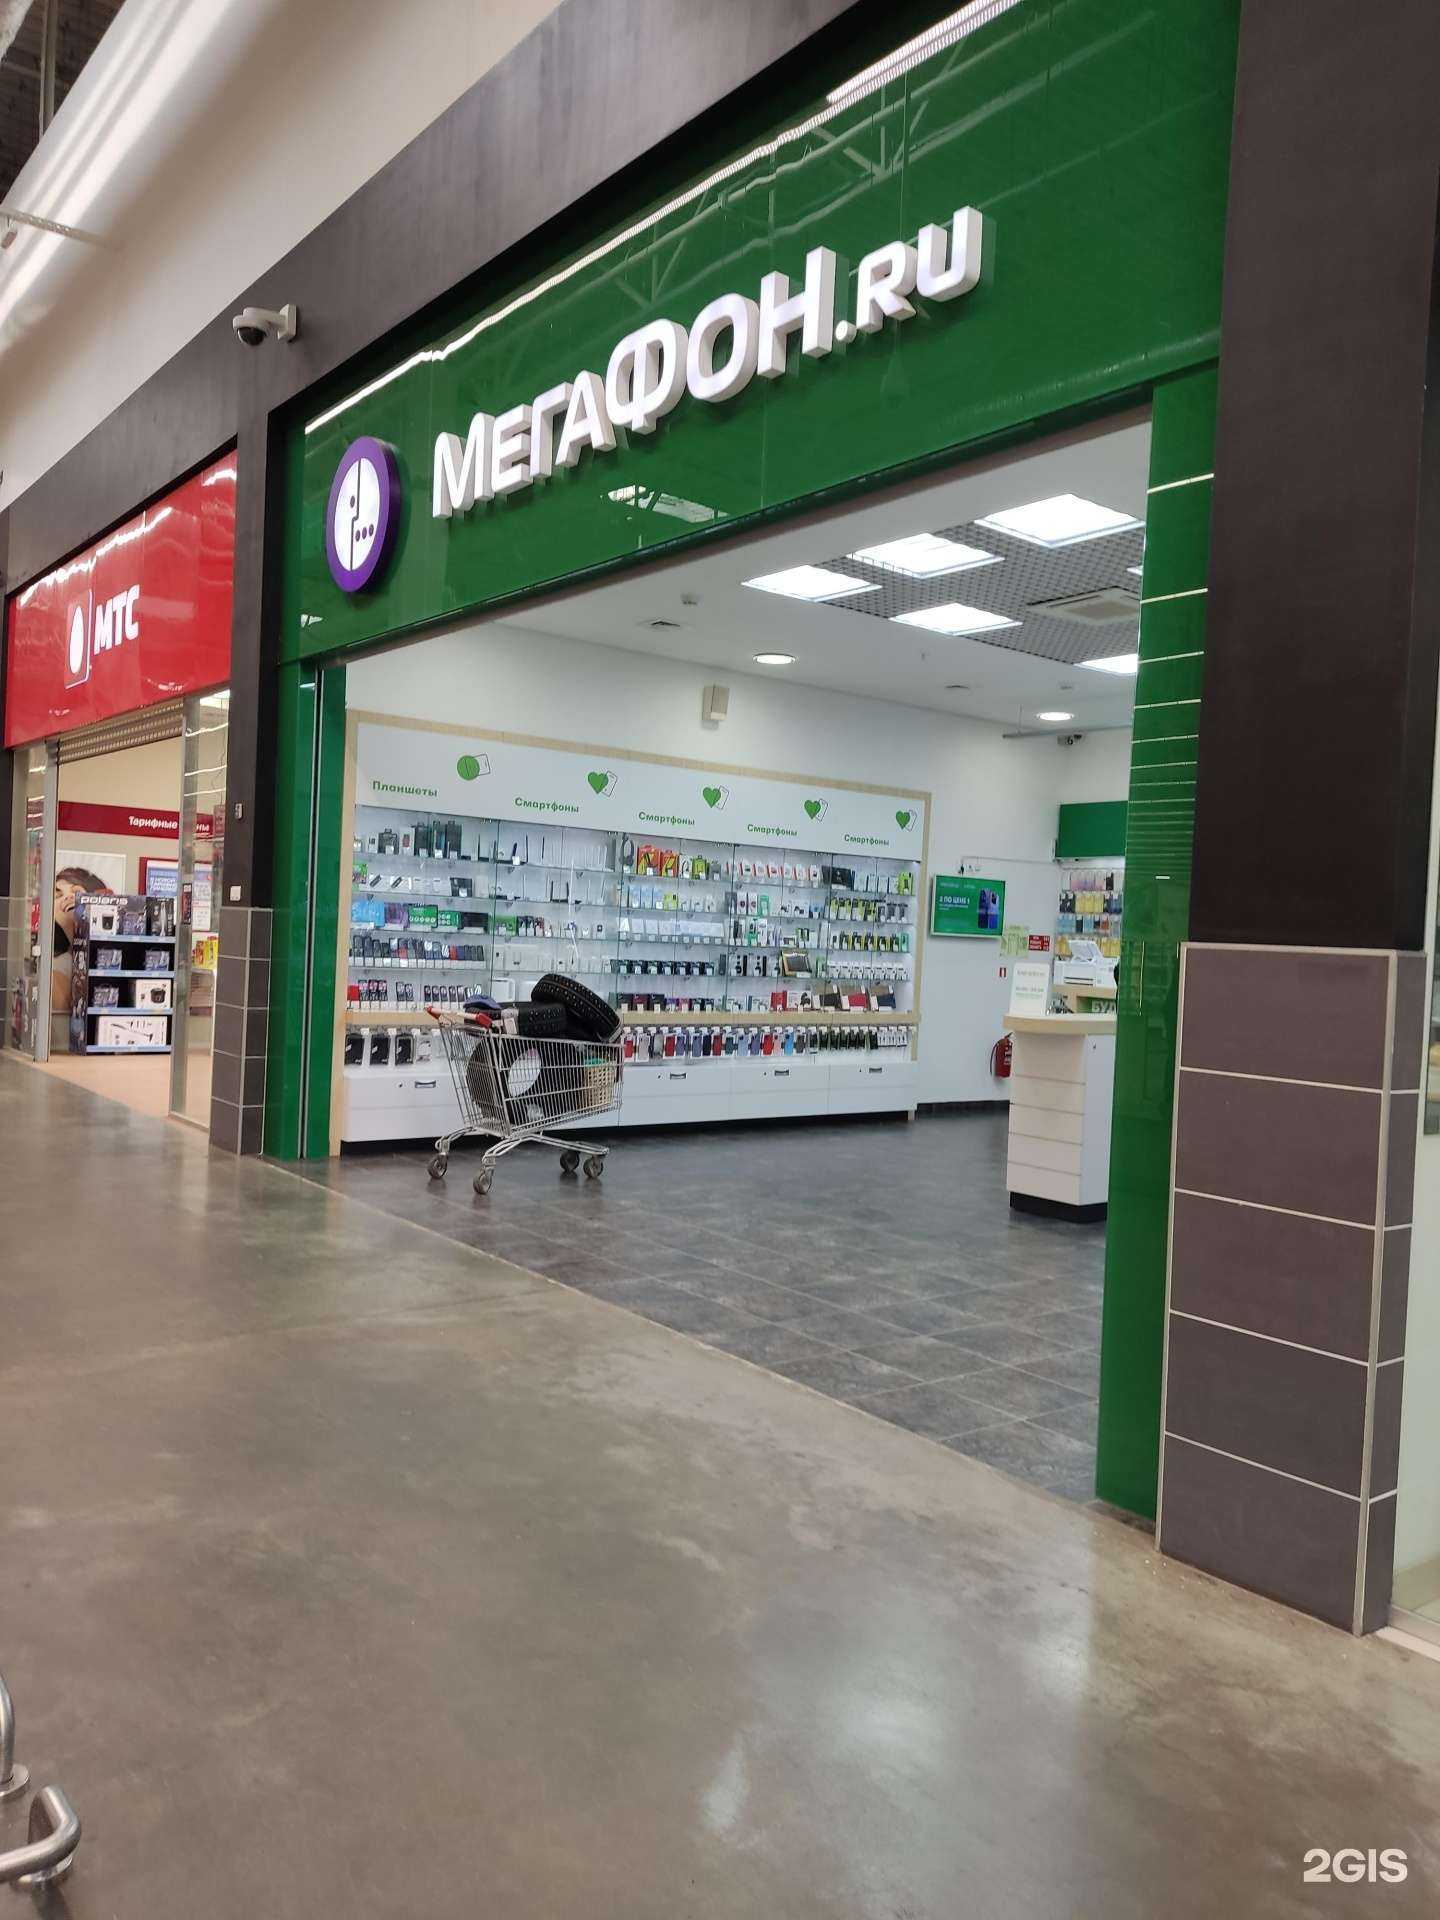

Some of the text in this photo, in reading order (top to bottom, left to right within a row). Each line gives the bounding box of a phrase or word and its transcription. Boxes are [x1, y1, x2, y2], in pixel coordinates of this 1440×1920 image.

[94, 584, 140, 655] МТС
[372, 780, 437, 797] Планшеты
[514, 797, 579, 813] Смартфоны
[129, 815, 178, 830] Тарифные
[638, 811, 695, 826] Смартфоны
[747, 823, 798, 838] Смартфоны
[844, 833, 890, 846] Смартфоны
